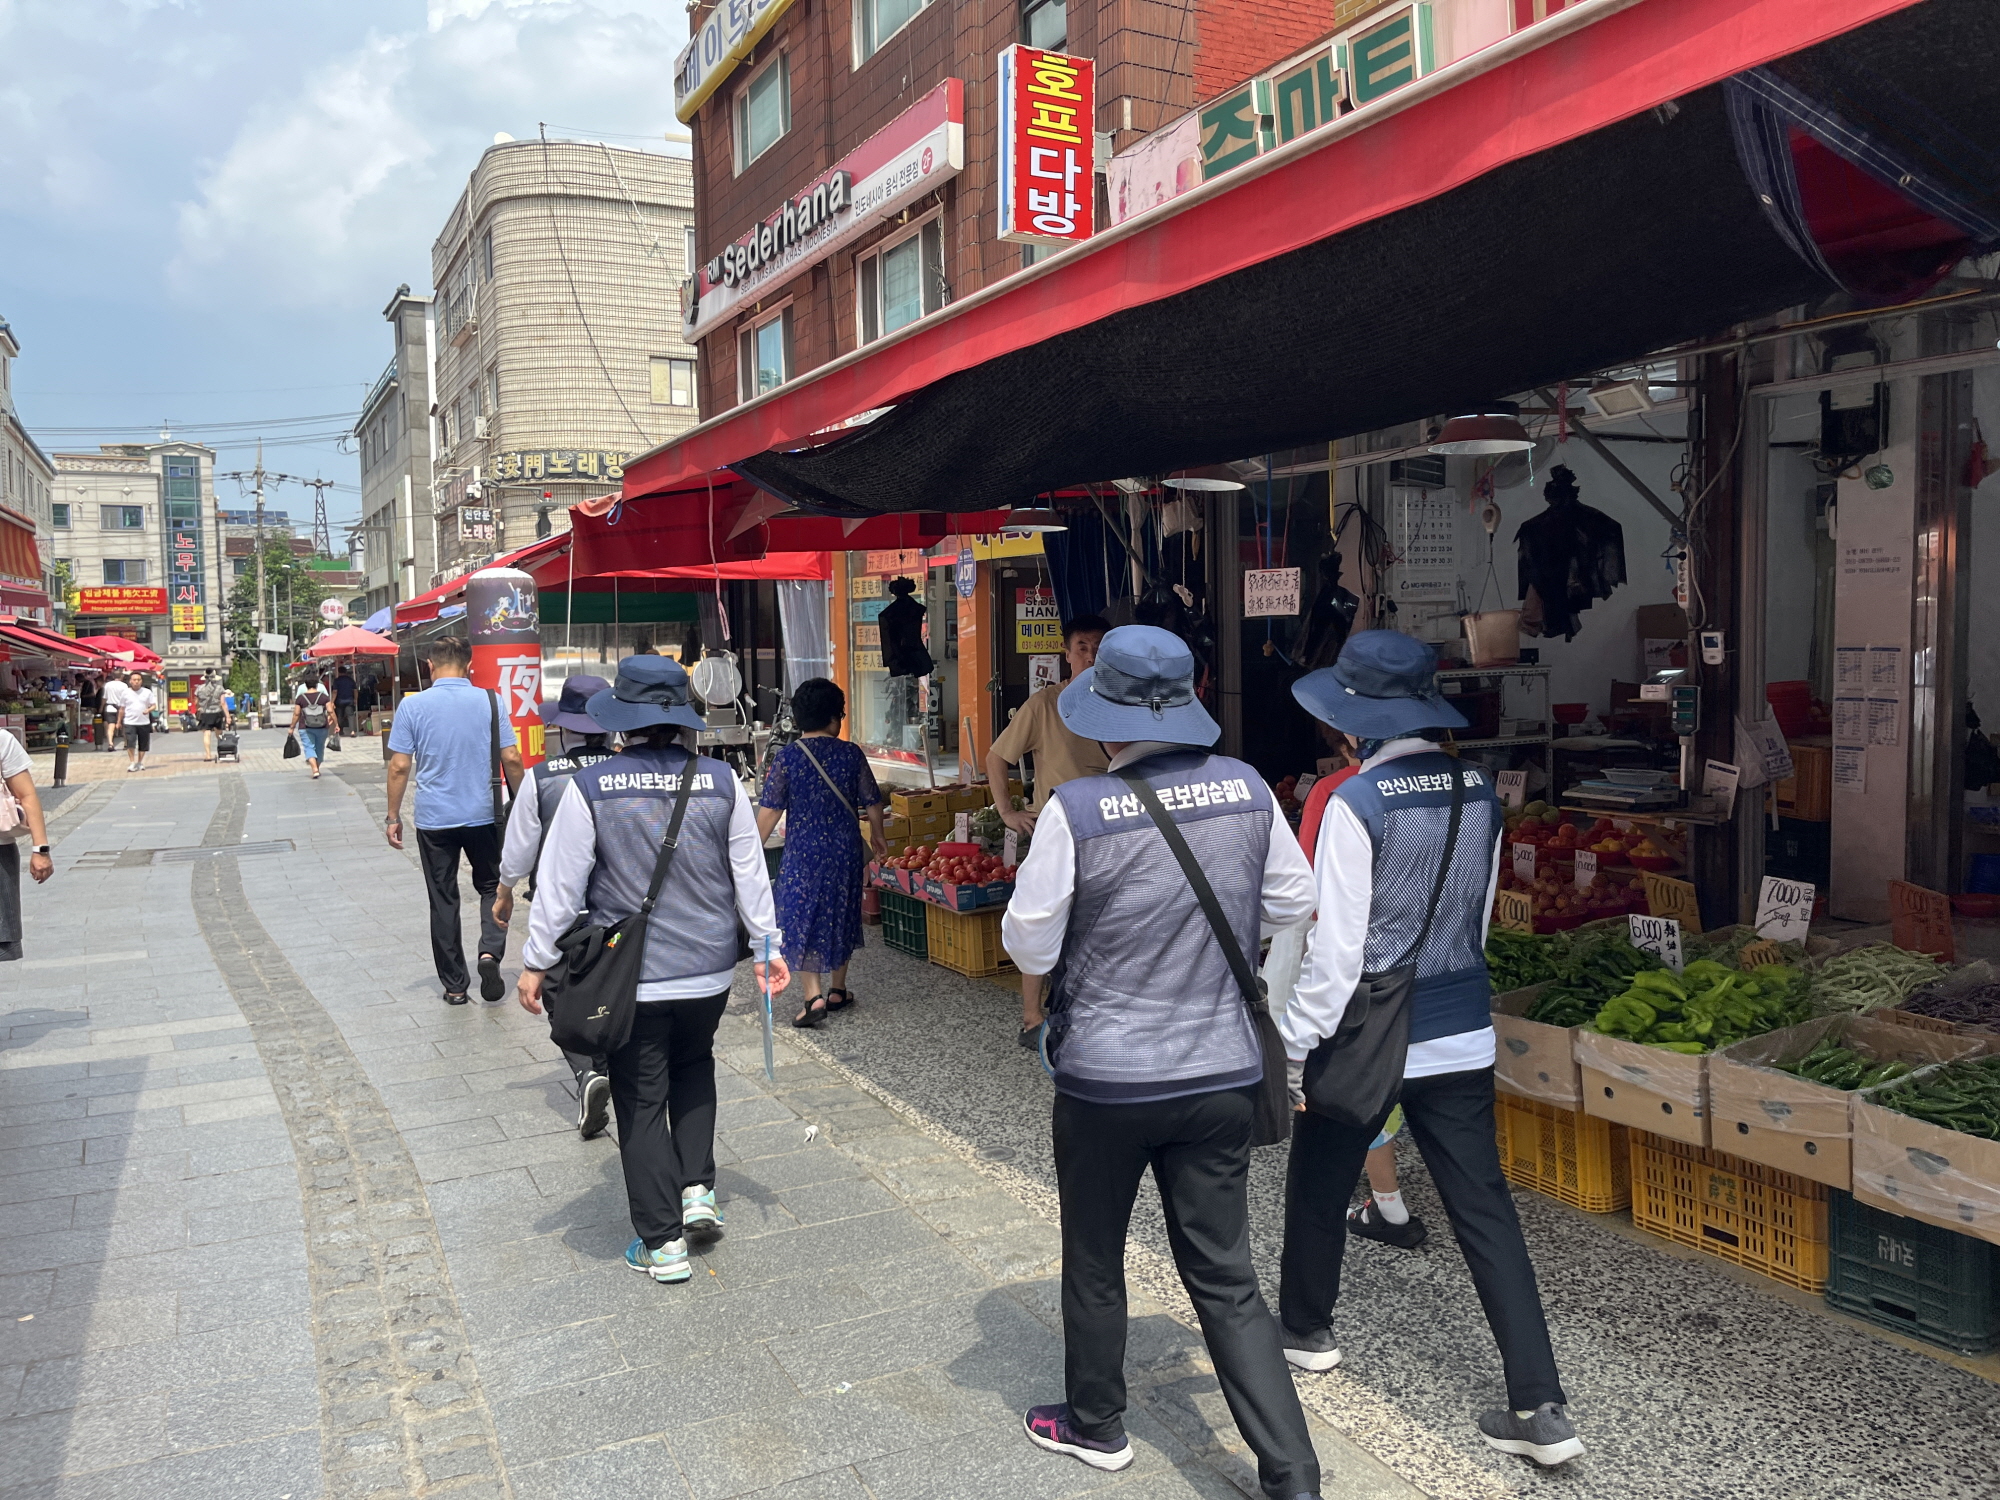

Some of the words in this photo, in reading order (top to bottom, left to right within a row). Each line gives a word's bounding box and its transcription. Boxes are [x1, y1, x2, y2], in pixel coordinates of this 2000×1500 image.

[1027, 54, 1082, 235] 호프다방
[855, 182, 884, 217] 인도네시아
[886, 177, 898, 198] 음식
[899, 158, 919, 188] 전문점
[707, 256, 722, 284] RM
[723, 169, 851, 288] Sederhana
[757, 256, 784, 288] MASAKAN
[785, 245, 802, 265] KHAS
[803, 222, 838, 254] INDONESIA
[175, 533, 198, 604] 노무사
[959, 564, 973, 581] ADT
[322, 605, 344, 615] 정육점
[1022, 641, 1059, 650] 031-495-5420
[497, 654, 541, 717] 夜
[1376, 770, 1484, 797] 안산시로보캅찰대
